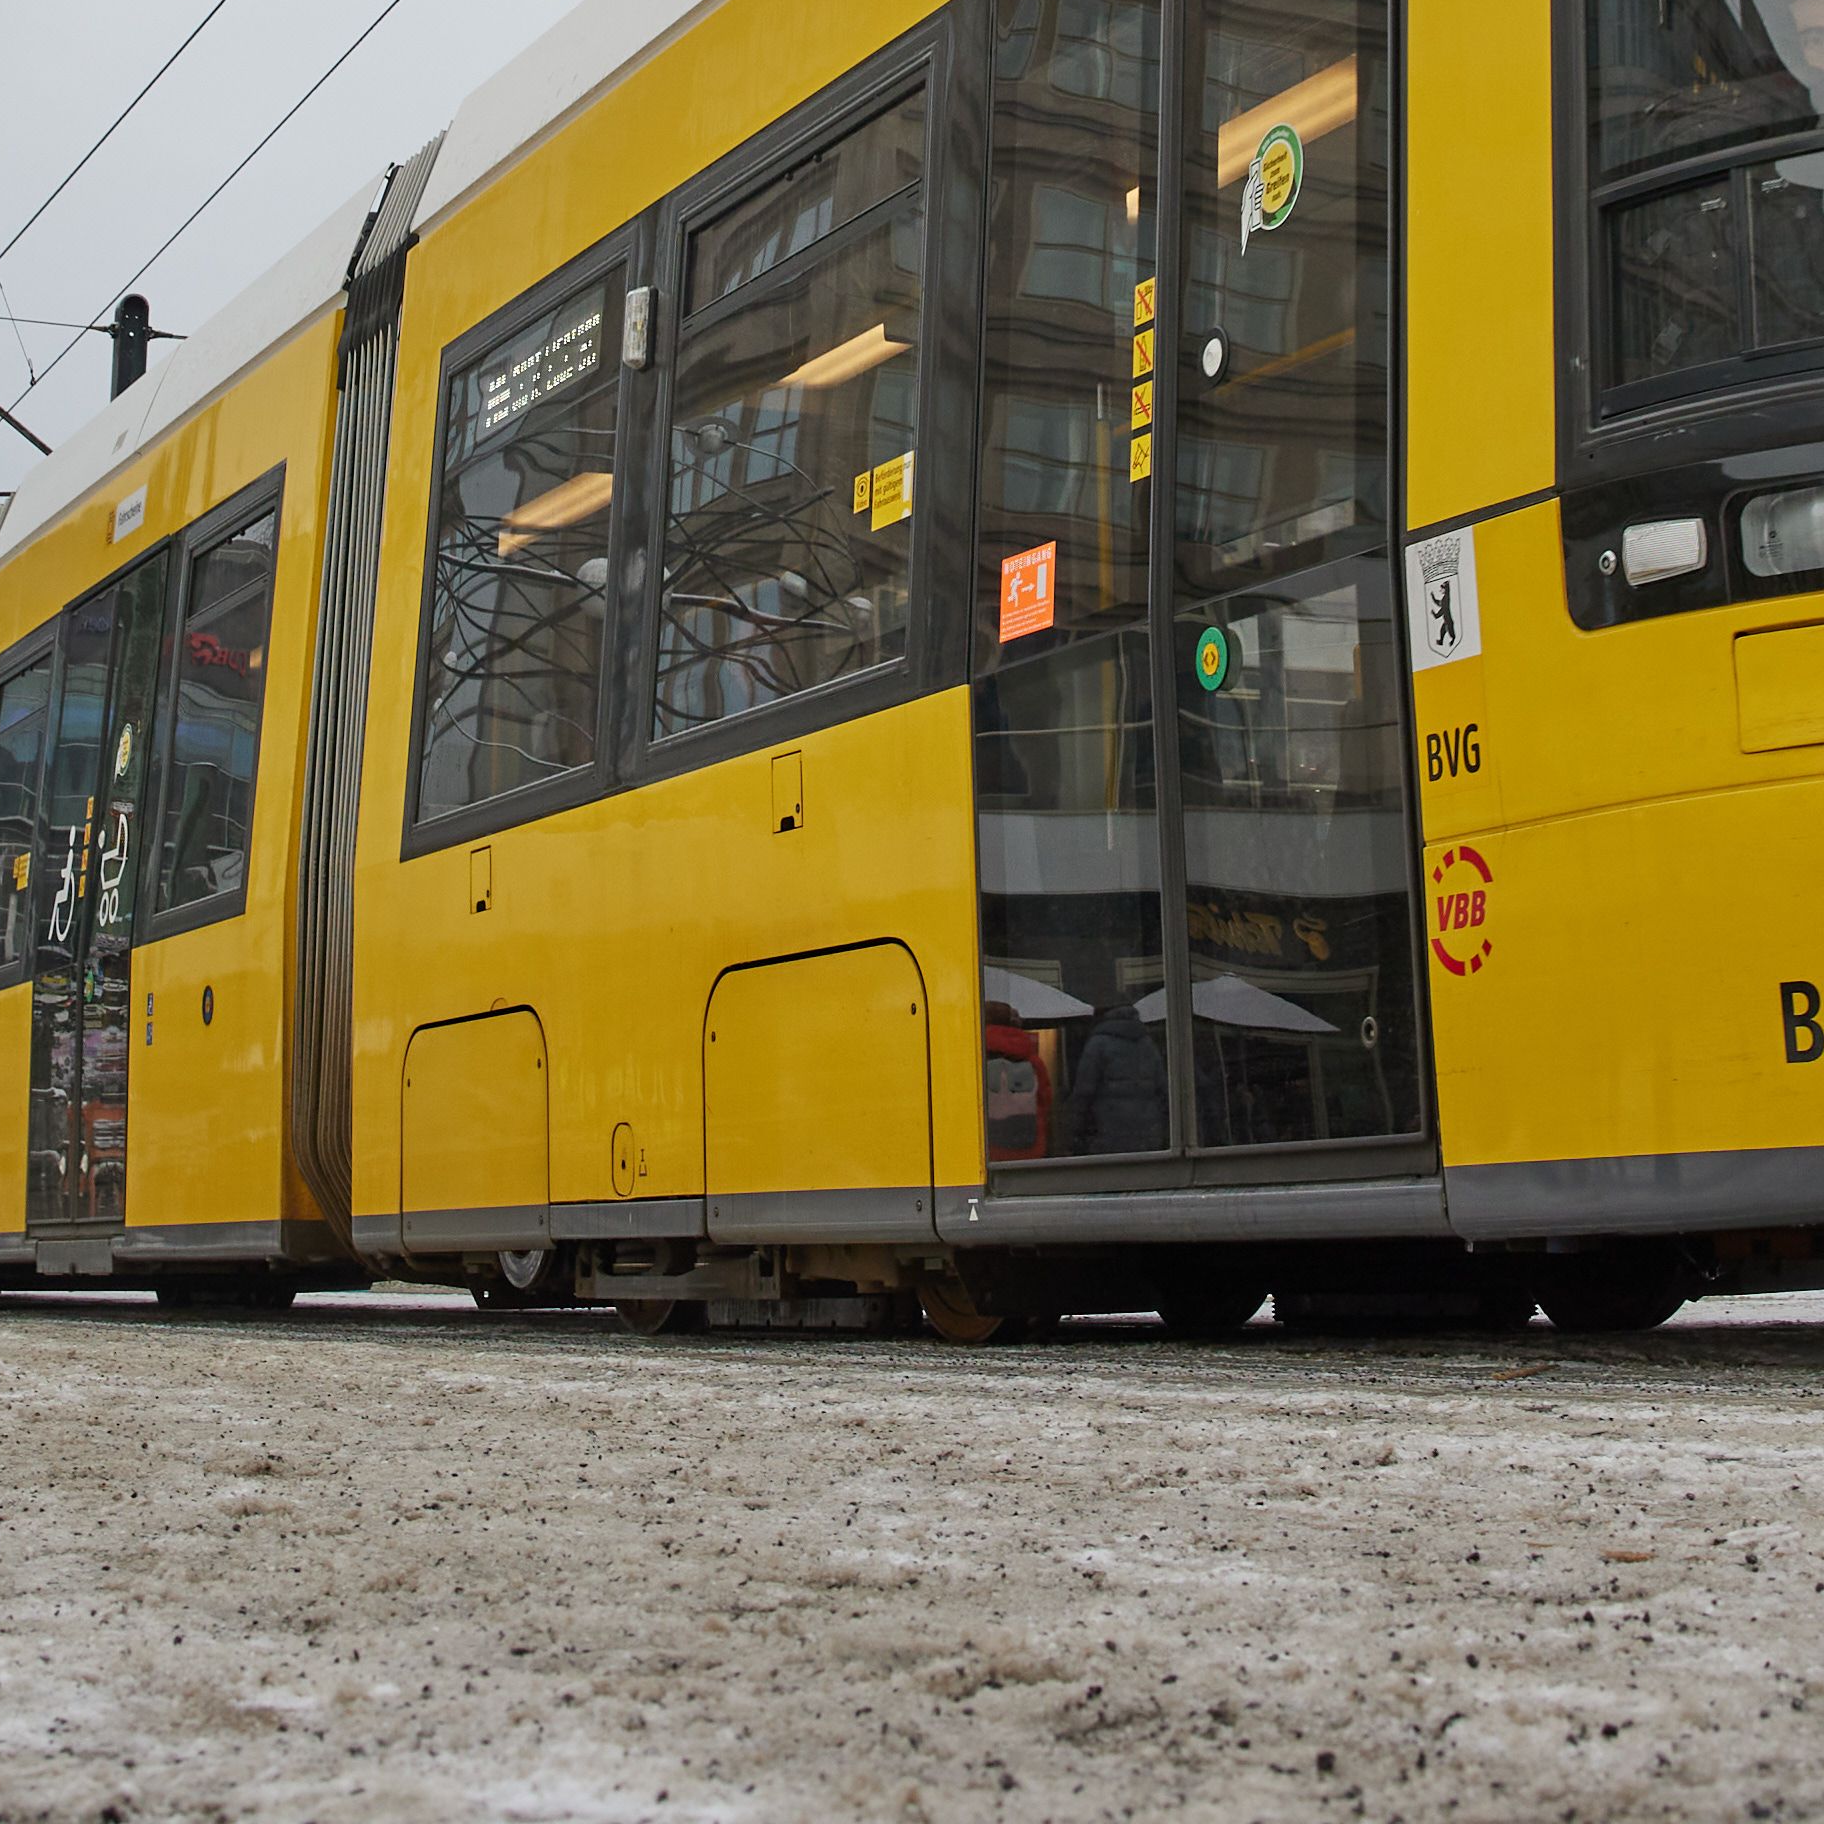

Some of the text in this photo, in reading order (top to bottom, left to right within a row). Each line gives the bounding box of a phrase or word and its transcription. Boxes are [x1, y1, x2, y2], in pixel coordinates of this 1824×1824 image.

[1266, 173, 1290, 194] Greifen
[1426, 723, 1480, 782] BVG
[1437, 890, 1486, 932] VBB
